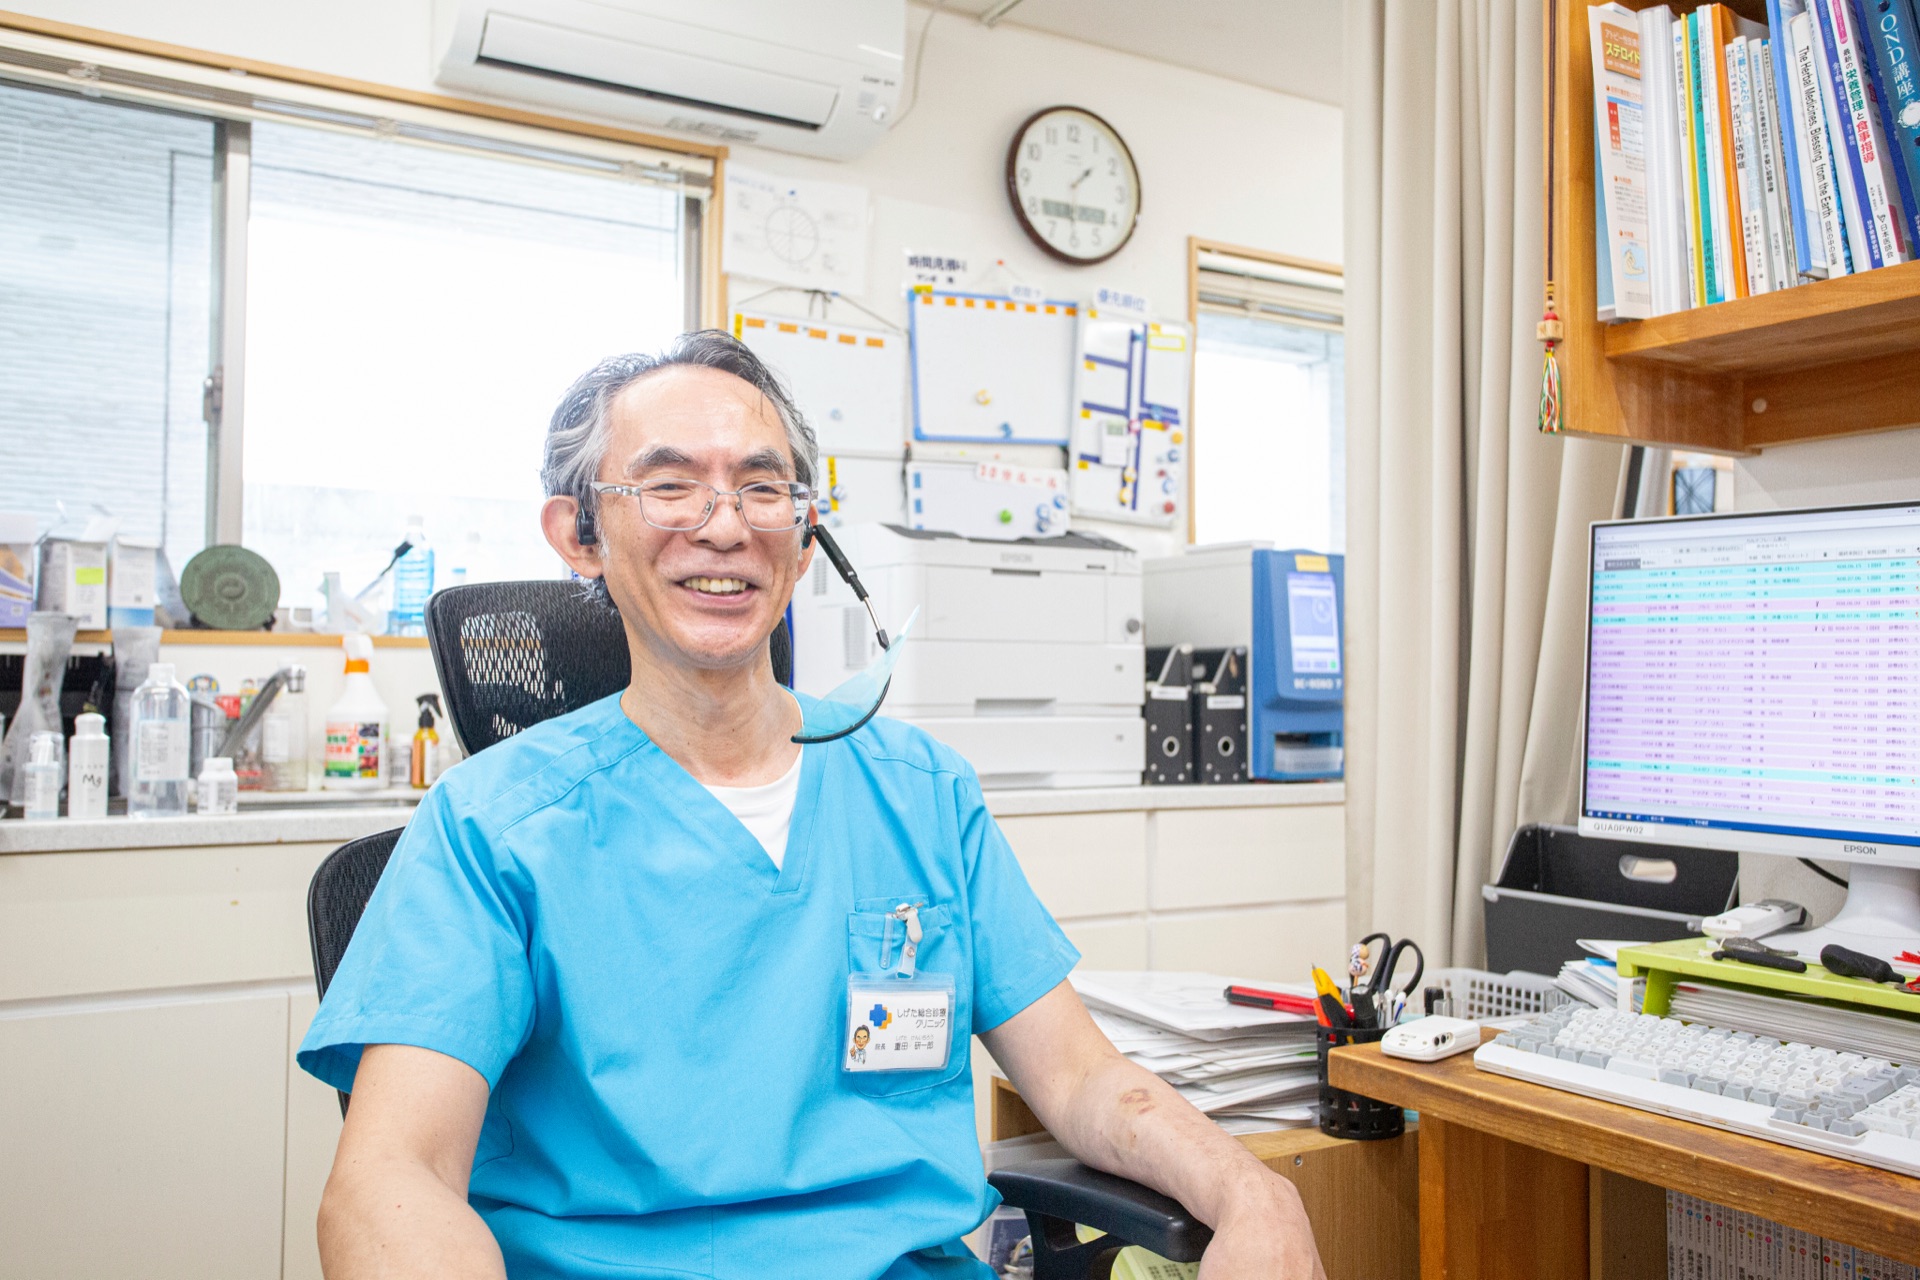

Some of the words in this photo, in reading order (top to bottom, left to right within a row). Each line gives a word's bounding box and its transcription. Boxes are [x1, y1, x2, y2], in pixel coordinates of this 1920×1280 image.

[1798, 45, 1810, 63] The
[1880, 14, 1915, 99] OND講座
[1800, 63, 1813, 87] Herbal
[1803, 86, 1818, 129] Medicines,
[1842, 48, 1875, 164] 最新の栄養管理と食事指導
[1046, 127, 1057, 145] 11
[1067, 123, 1080, 144] 12
[1732, 104, 1745, 169] アルコール依存症
[1027, 143, 1041, 161] 10
[1809, 127, 1822, 163] Blessing
[1107, 157, 1118, 176] 2
[1815, 163, 1826, 182] from
[1020, 167, 1031, 186] 9
[1116, 185, 1125, 204] 3
[1818, 181, 1829, 196] the
[1027, 196, 1038, 215] 8
[1820, 195, 1834, 219] Earth
[1048, 219, 1057, 238] 7
[1110, 212, 1118, 228] 4
[1091, 227, 1102, 246] 5
[1880, 223, 1894, 258] 日本医師会
[1001, 553, 1033, 563] EPSON
[82, 773, 102, 787] Mg
[1843, 845, 1877, 855] EPSON
[897, 1008, 946, 1018] しげた総合診療
[916, 1018, 946, 1029] クリニック
[894, 1042, 908, 1051] 重田
